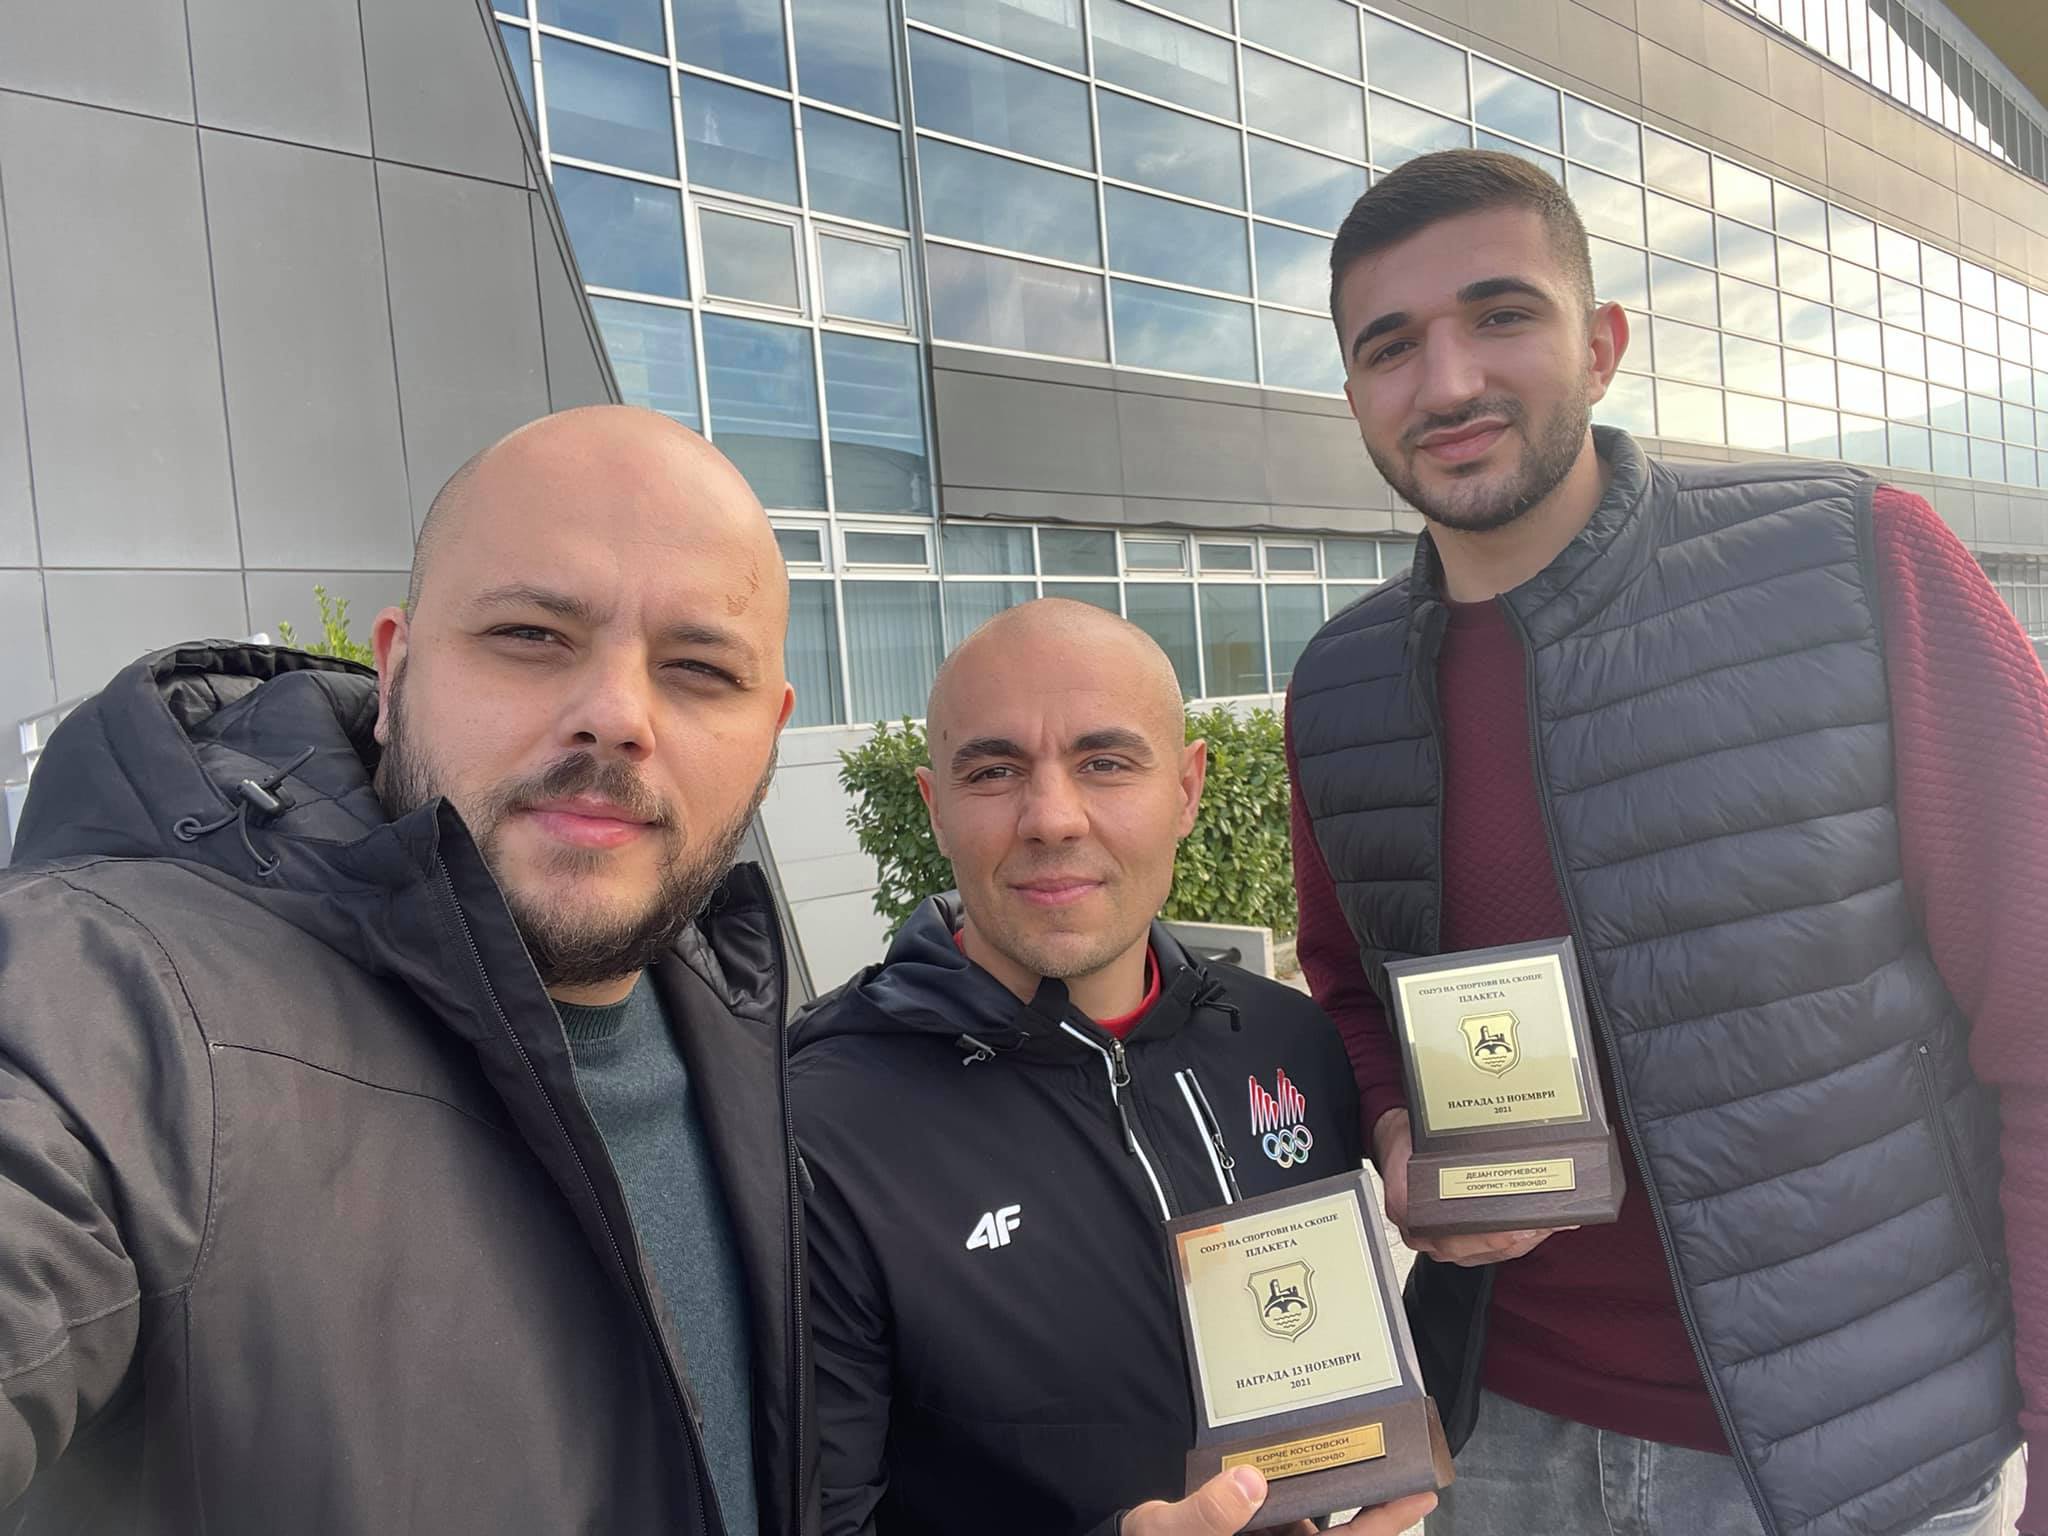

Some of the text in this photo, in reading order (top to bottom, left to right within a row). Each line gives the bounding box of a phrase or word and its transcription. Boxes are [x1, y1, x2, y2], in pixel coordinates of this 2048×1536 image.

[1444, 985, 1455, 993] НА
[1456, 980, 1498, 990] СПОРТОВИ
[1459, 991, 1506, 1003] ПЛАКЕТА
[1448, 1090, 1556, 1109] НАГРАДА 13 НОЕМВРИ
[1494, 1106, 1512, 1114] 2021
[1466, 1166, 1547, 1180] ДЕЈАН ГОРГИЕВСКИ
[1466, 1182, 1503, 1191] СПОРТИСТ
[1509, 1179, 1547, 1188] ТЕКВОНДО
[966, 1204, 1021, 1250] 4F
[1200, 1213, 1339, 1254] СОЈУЗ НА СПОРТОВИ НА СКОПЈЕ
[1246, 1238, 1298, 1258] ПЛАКЕТА
[1236, 1352, 1361, 1389] НАГРАДА 13 НОЕМВРИ
[1290, 1378, 1312, 1389] 2021
[1255, 1437, 1349, 1463] БОРЧЕ КОСТОВСКИ
[1262, 1462, 1294, 1474] ТРЕНЕР
